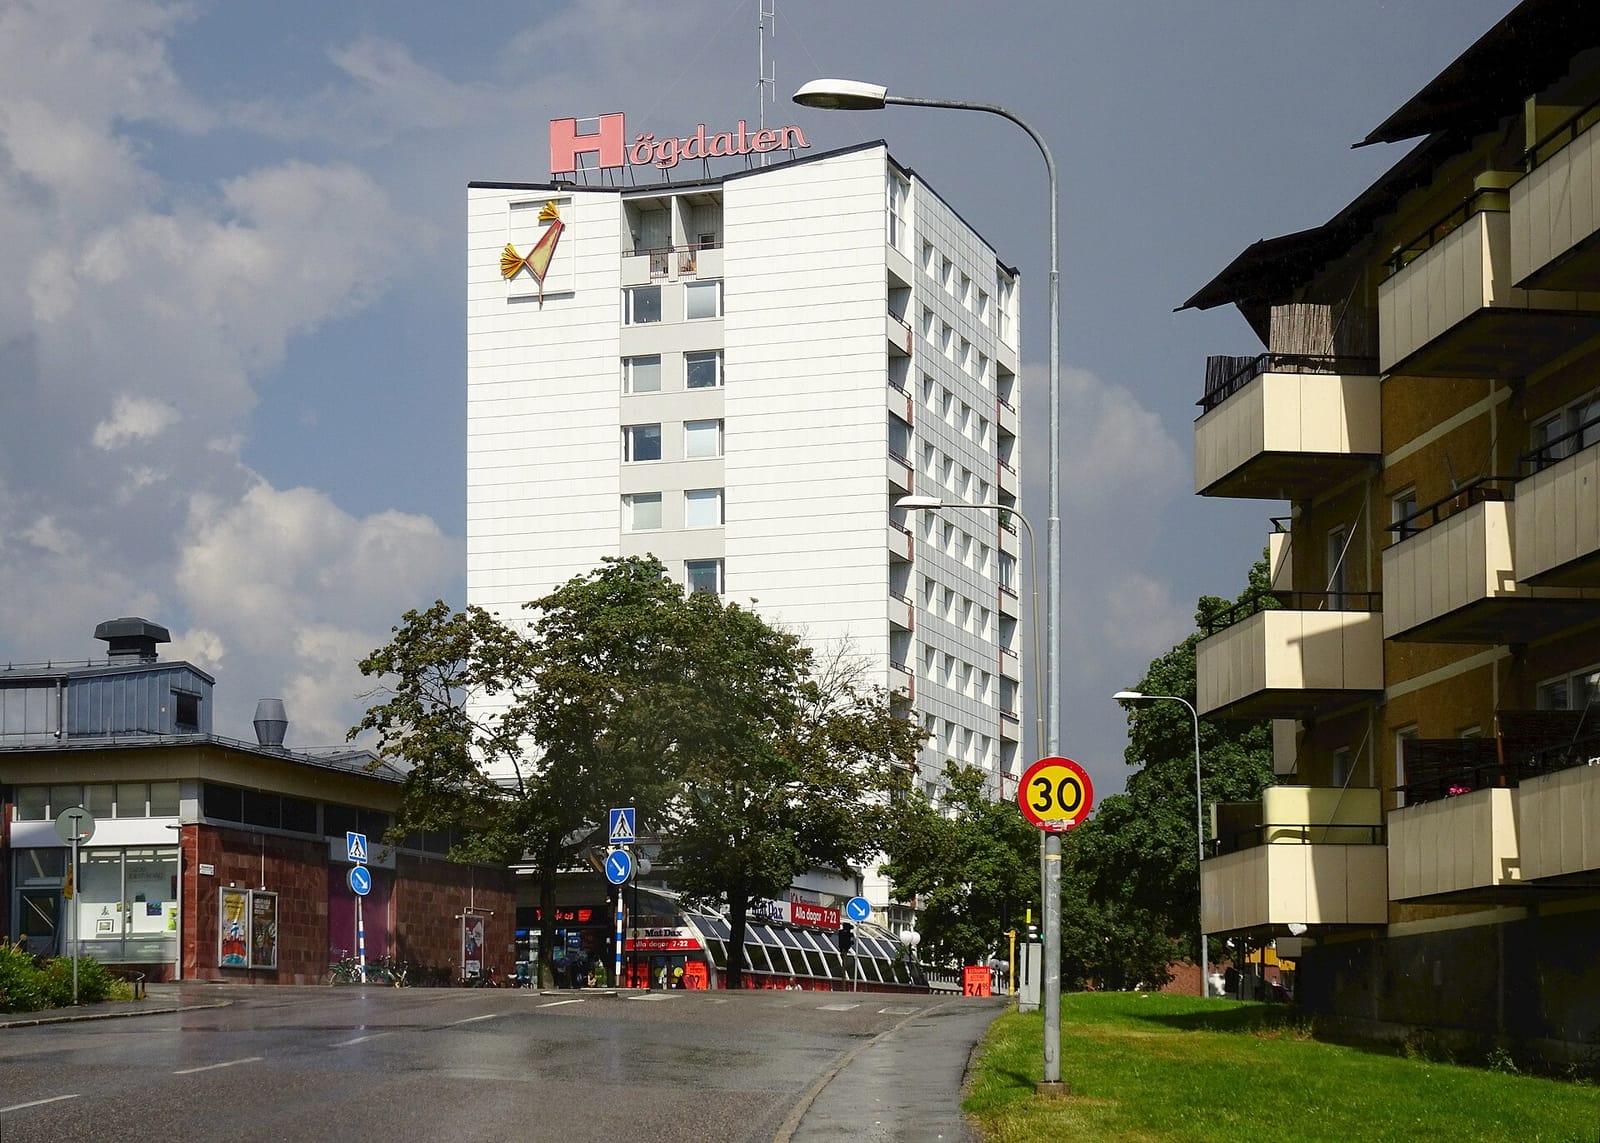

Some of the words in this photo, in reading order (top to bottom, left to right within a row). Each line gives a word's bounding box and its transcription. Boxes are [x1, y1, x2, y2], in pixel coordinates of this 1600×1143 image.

[550, 112, 811, 174] Högdalen
[1032, 776, 1082, 812] 30
[795, 906, 806, 920] Alla
[806, 908, 822, 924] dagar
[824, 910, 837, 924] 7-22
